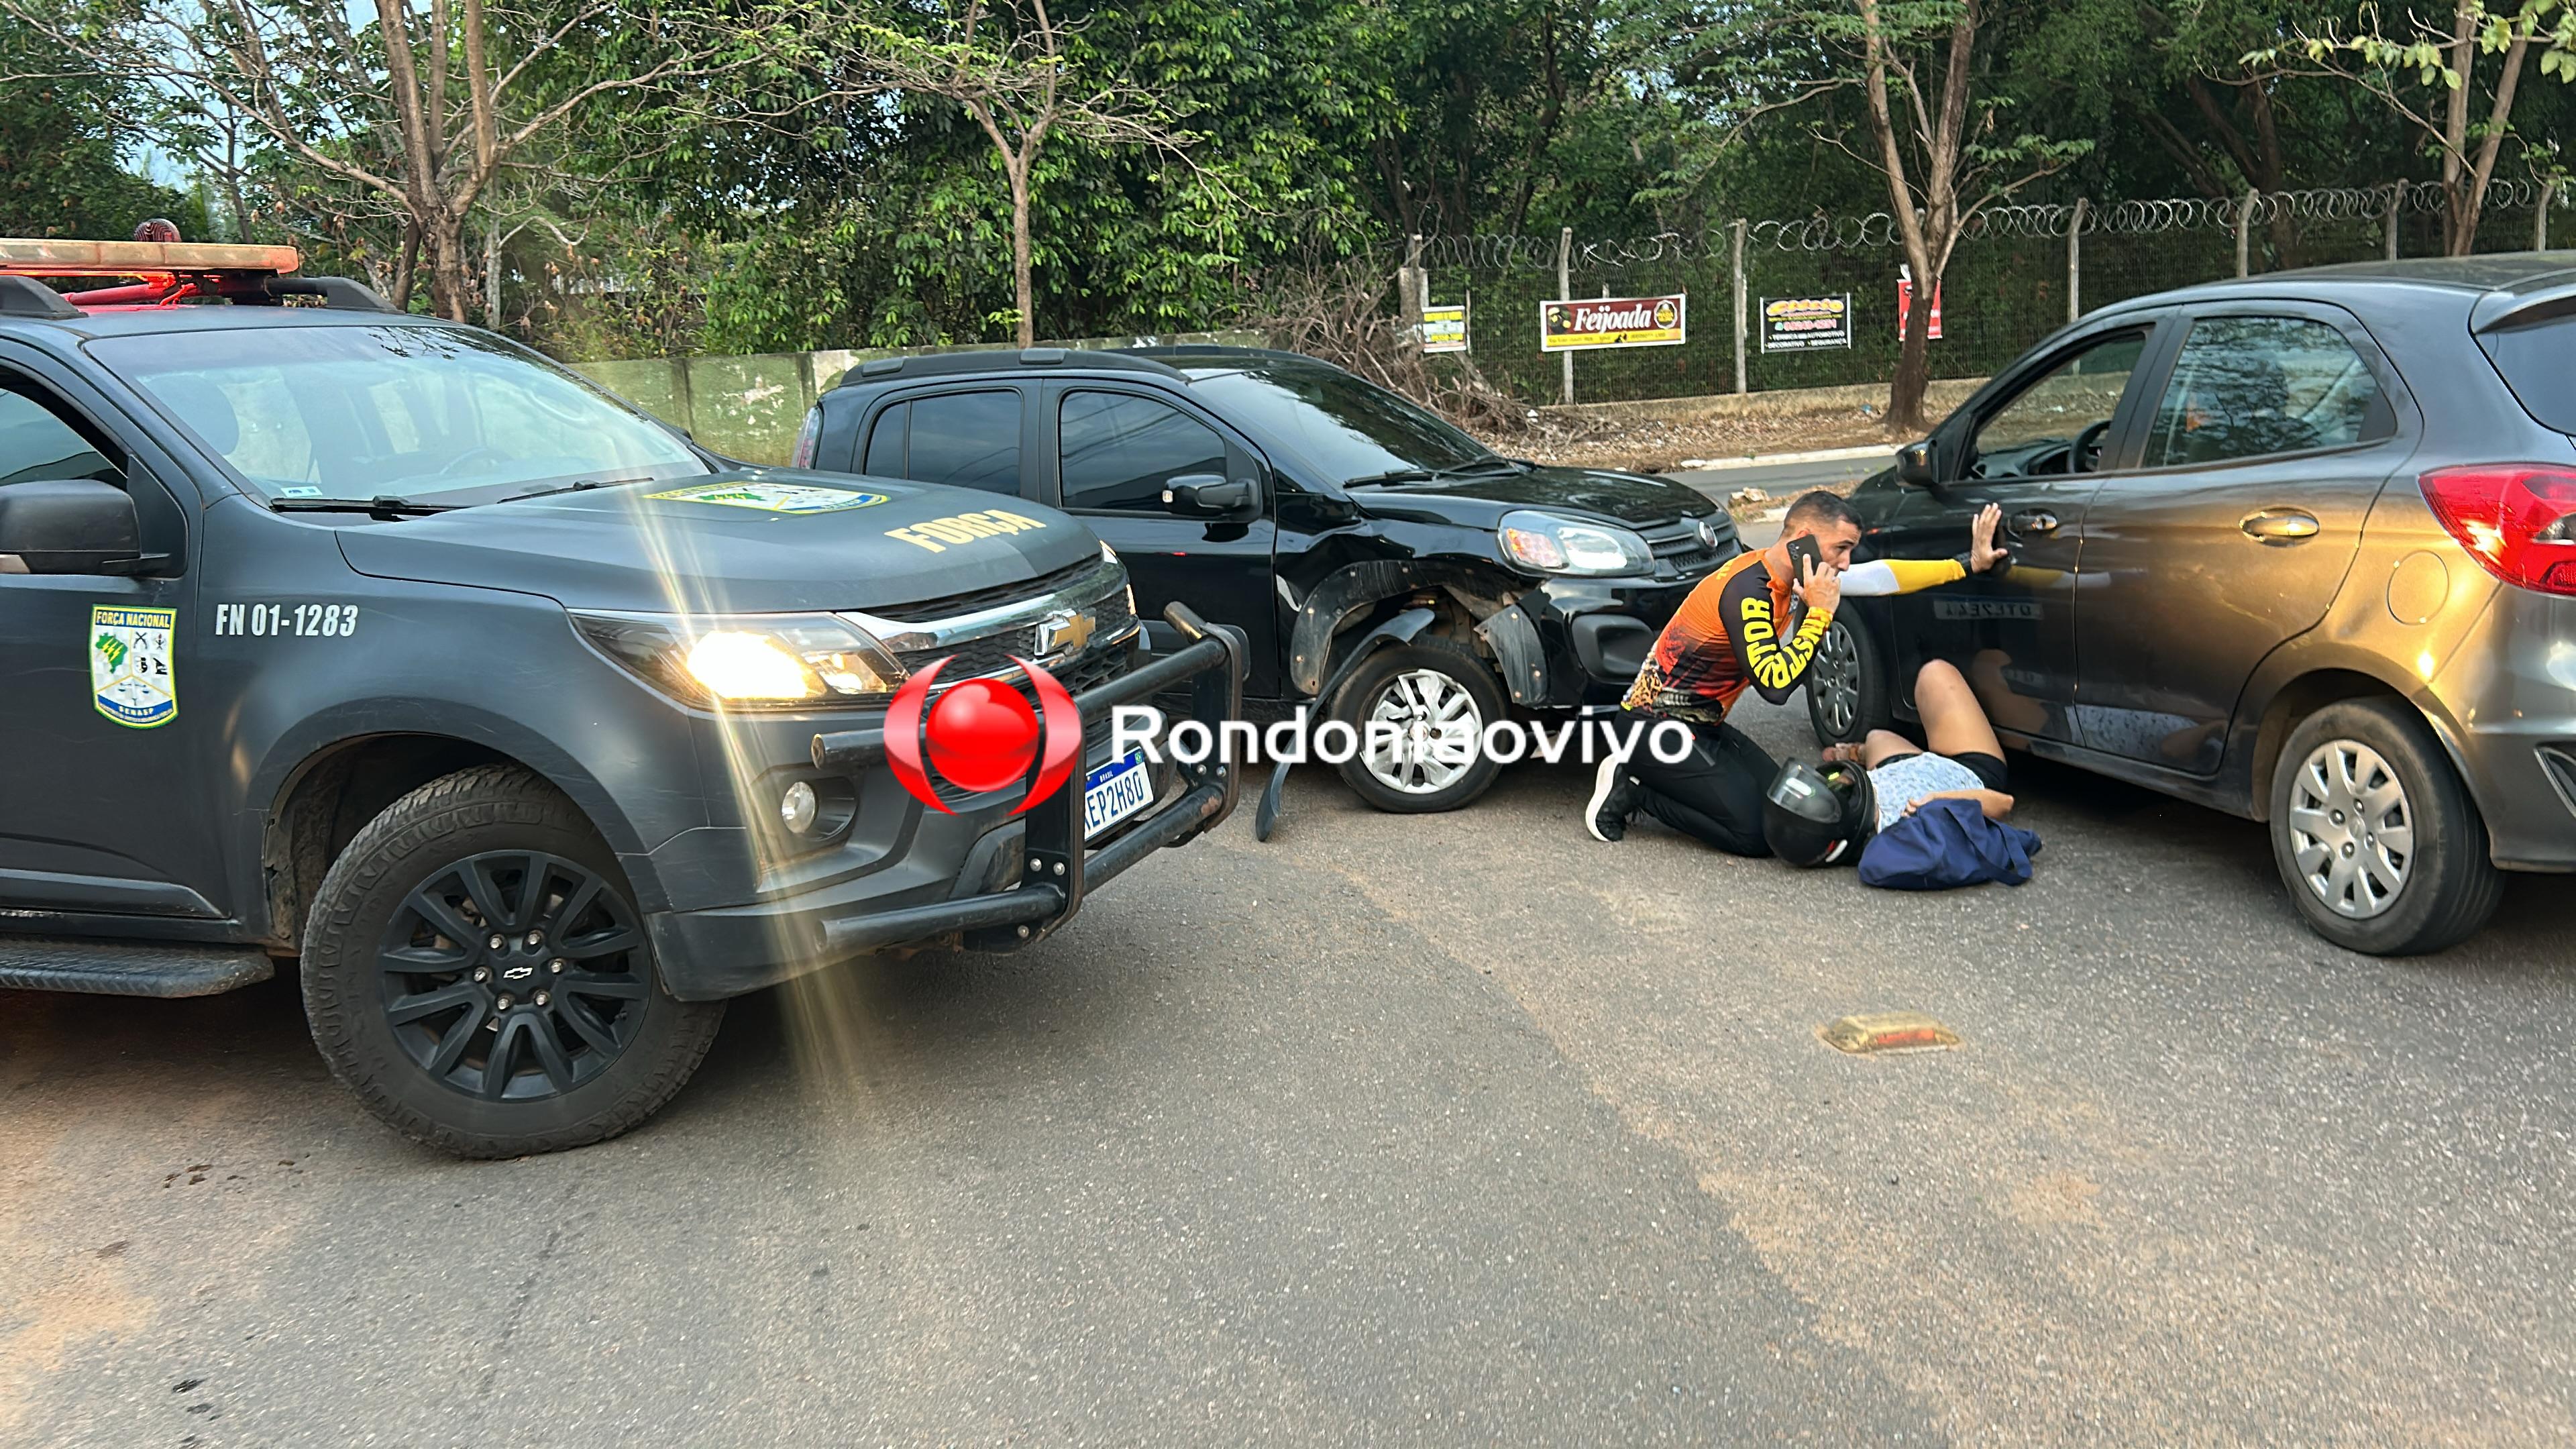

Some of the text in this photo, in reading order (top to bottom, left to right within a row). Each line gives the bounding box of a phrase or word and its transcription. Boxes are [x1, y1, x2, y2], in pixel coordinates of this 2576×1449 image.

[1574, 303, 1652, 334] Feijoada
[884, 509, 1046, 553] FORÇA
[96, 610, 170, 629] FORÇA NACIONAL
[215, 604, 359, 637] FN 01-1283
